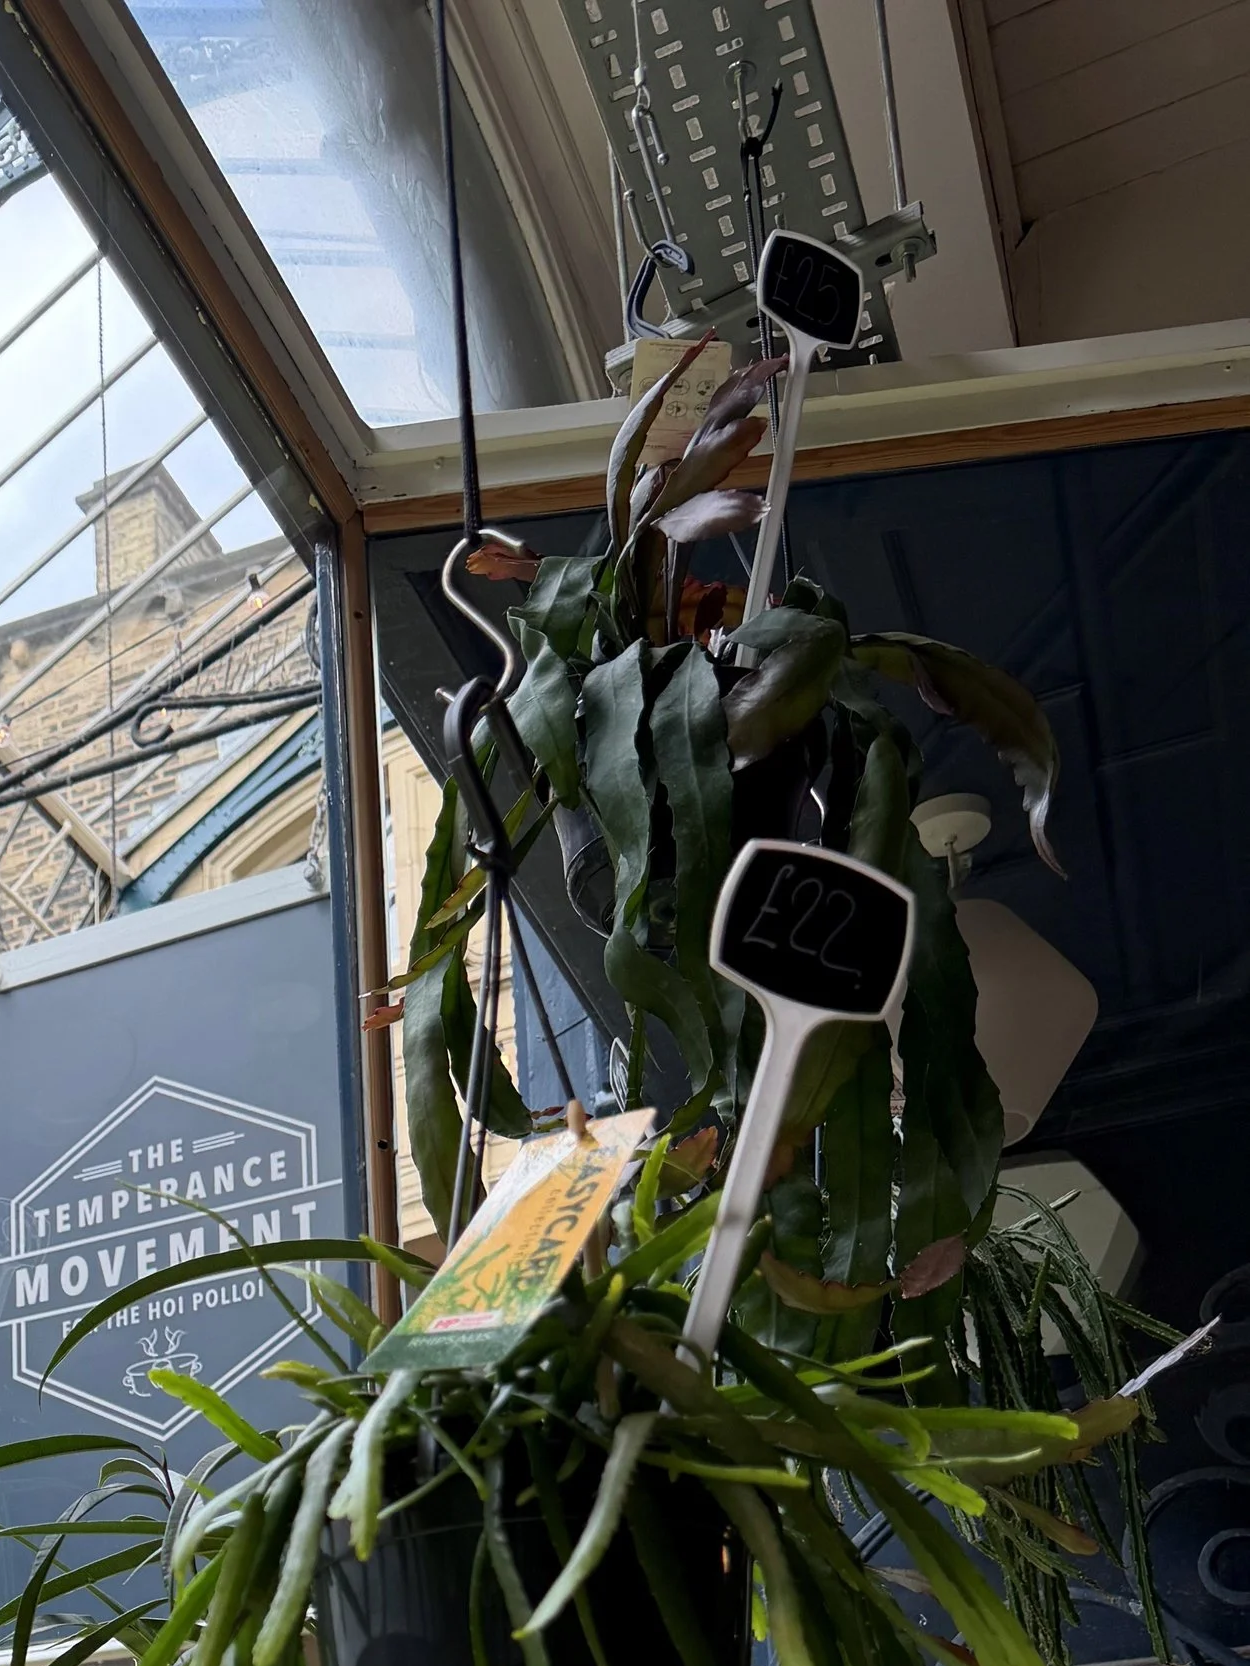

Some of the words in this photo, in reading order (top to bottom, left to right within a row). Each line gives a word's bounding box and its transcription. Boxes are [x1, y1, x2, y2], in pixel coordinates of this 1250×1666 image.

[128, 1138, 185, 1173] THE
[34, 1150, 288, 1238] TEMPERANCE
[14, 1202, 317, 1308] MOVEMENT
[148, 1295, 184, 1322] HOI
[192, 1278, 265, 1312] POLLOI
